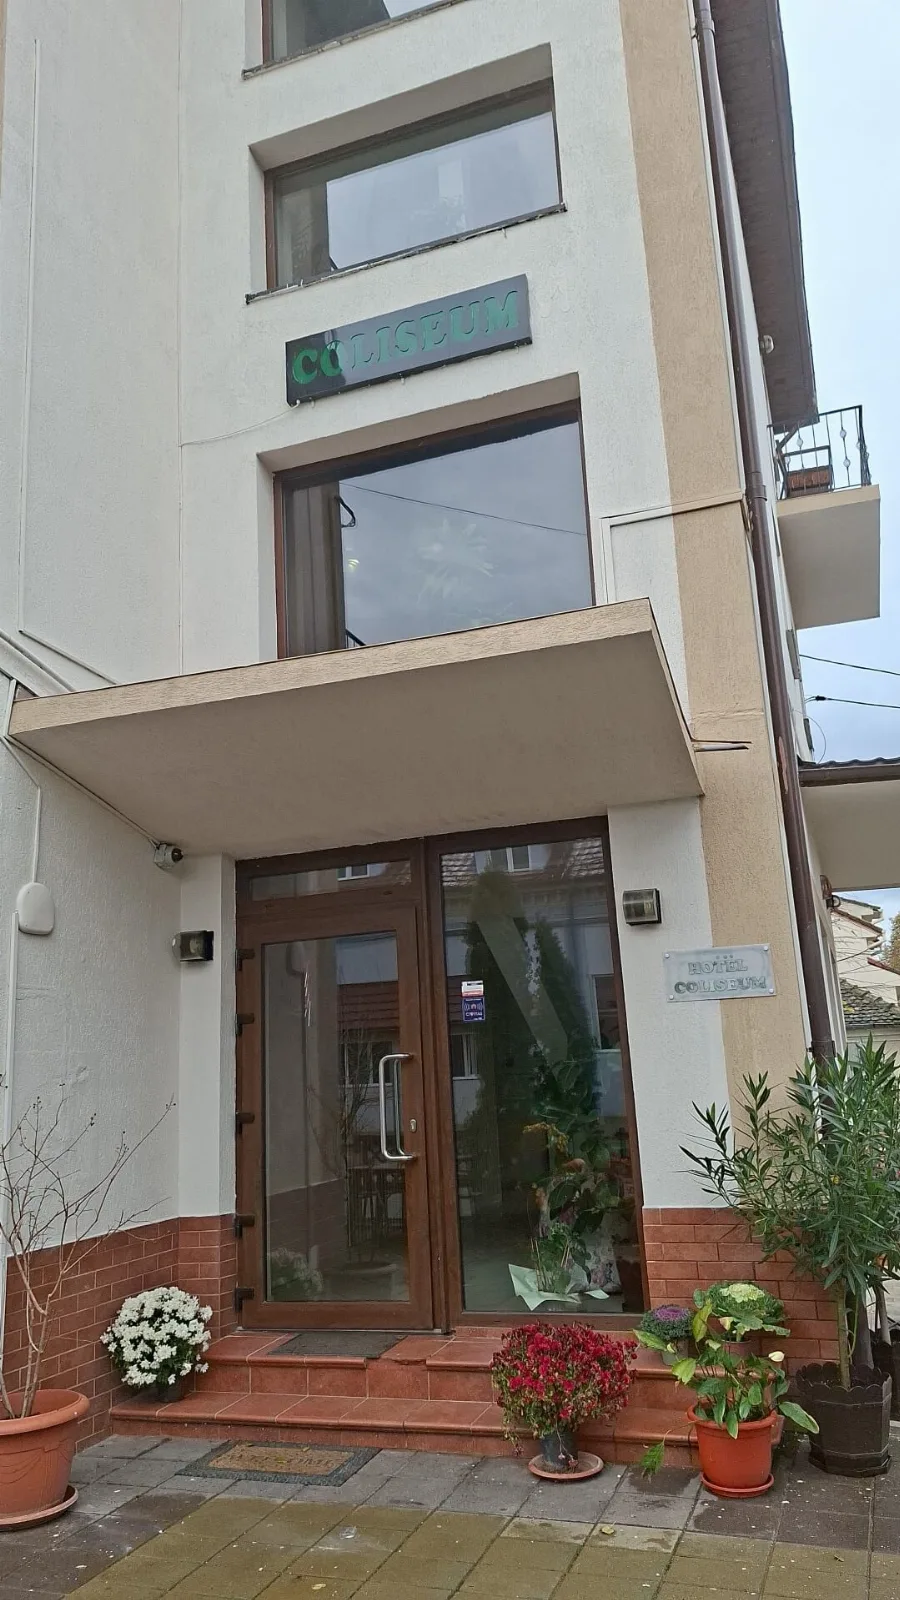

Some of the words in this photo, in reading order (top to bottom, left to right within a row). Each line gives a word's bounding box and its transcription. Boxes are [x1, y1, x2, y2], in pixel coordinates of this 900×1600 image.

[292, 290, 520, 384] COLISEUM
[688, 958, 748, 975] HOTEL
[674, 976, 766, 994] COLISEUM
